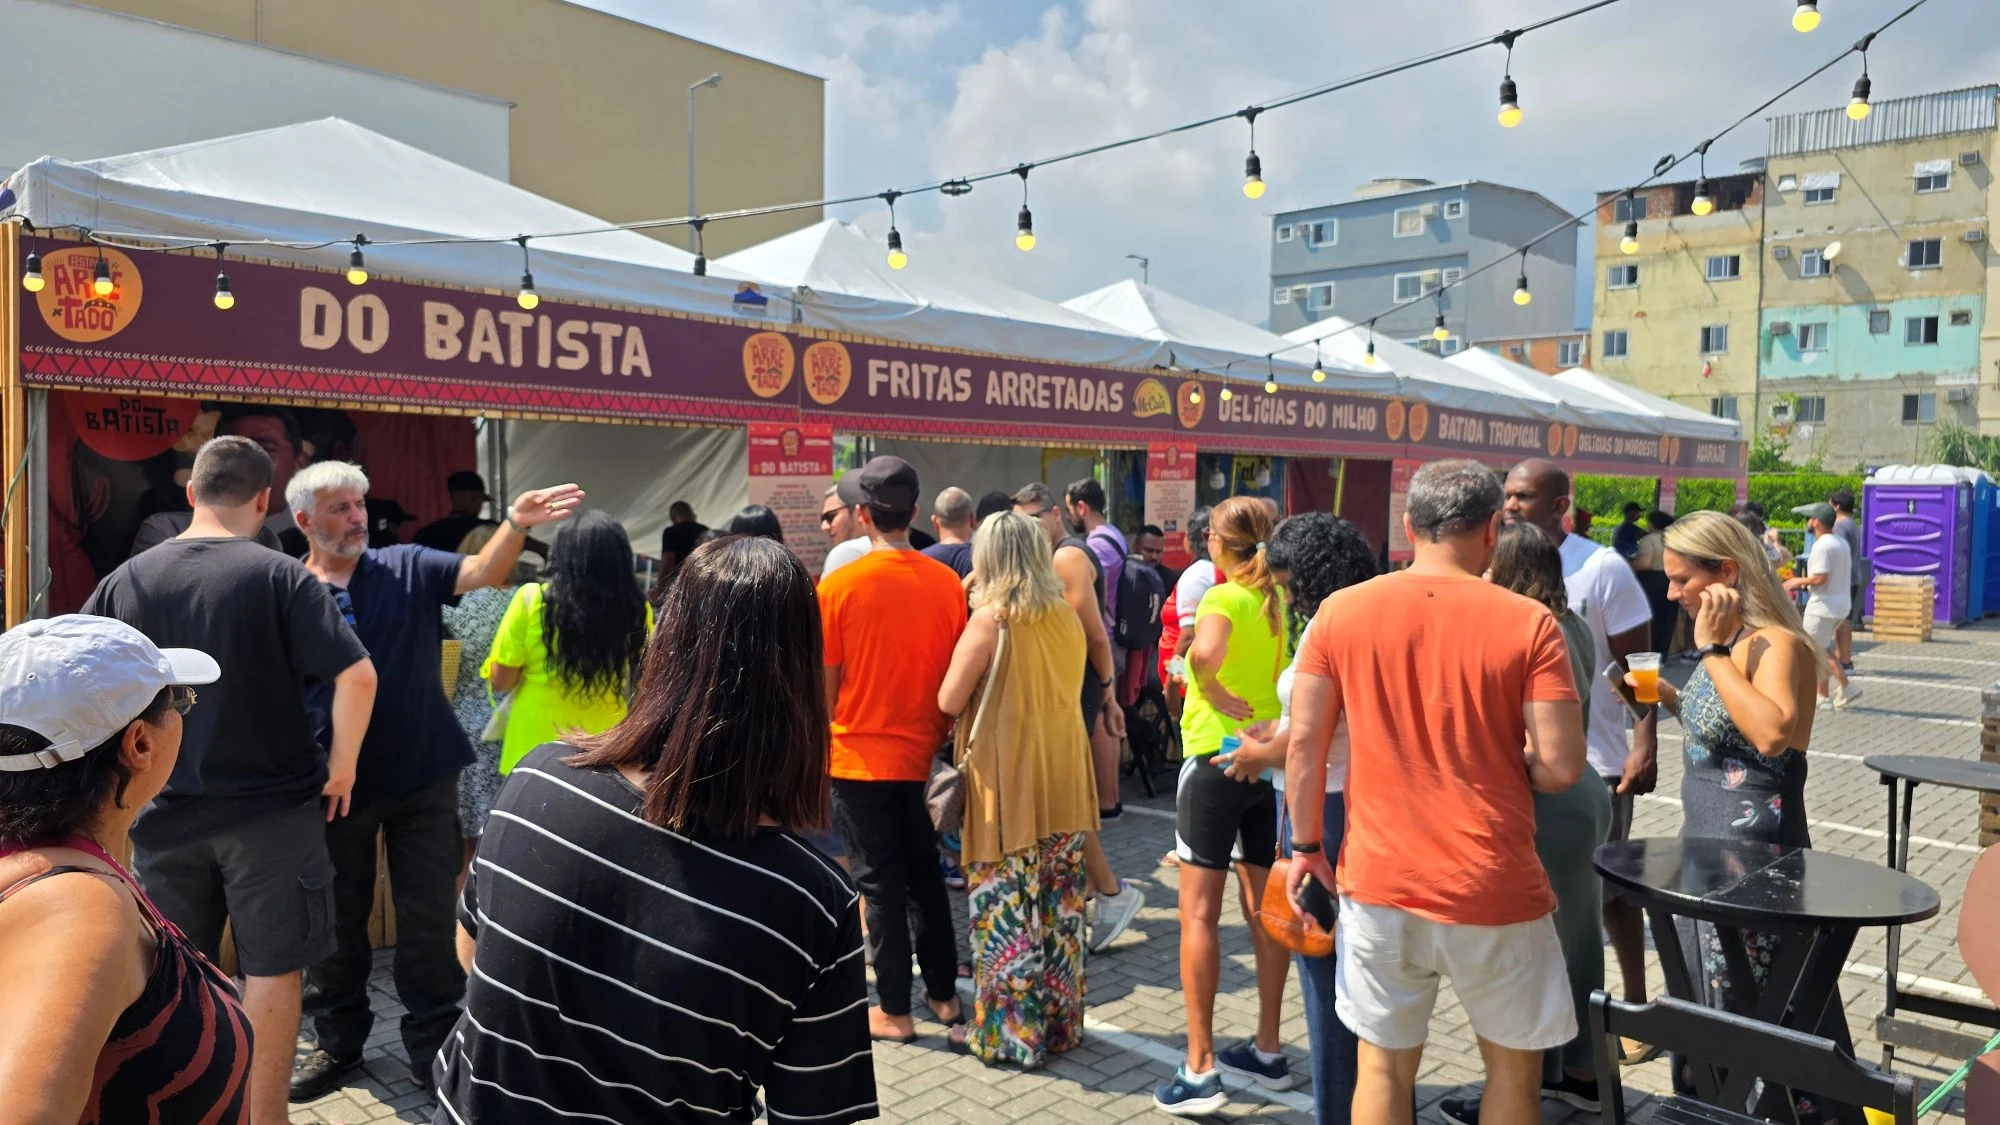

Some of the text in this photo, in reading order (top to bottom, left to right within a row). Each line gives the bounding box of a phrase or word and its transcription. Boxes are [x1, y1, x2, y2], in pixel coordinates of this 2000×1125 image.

[54, 264, 123, 300] ARE
[58, 296, 114, 331] TADO
[301, 287, 652, 377] DO BATISTA
[868, 359, 1124, 412] FRITAS ARRETADAS
[119, 398, 141, 412] DO
[1135, 393, 1166, 412] McCain
[1304, 400, 1326, 428] DO
[1332, 404, 1377, 431] MILHO
[86, 407, 180, 436] BATISTA
[1439, 413, 1484, 444] BATIDA
[1489, 421, 1541, 448] TROPICAL
[779, 461, 821, 475] BATISTA
